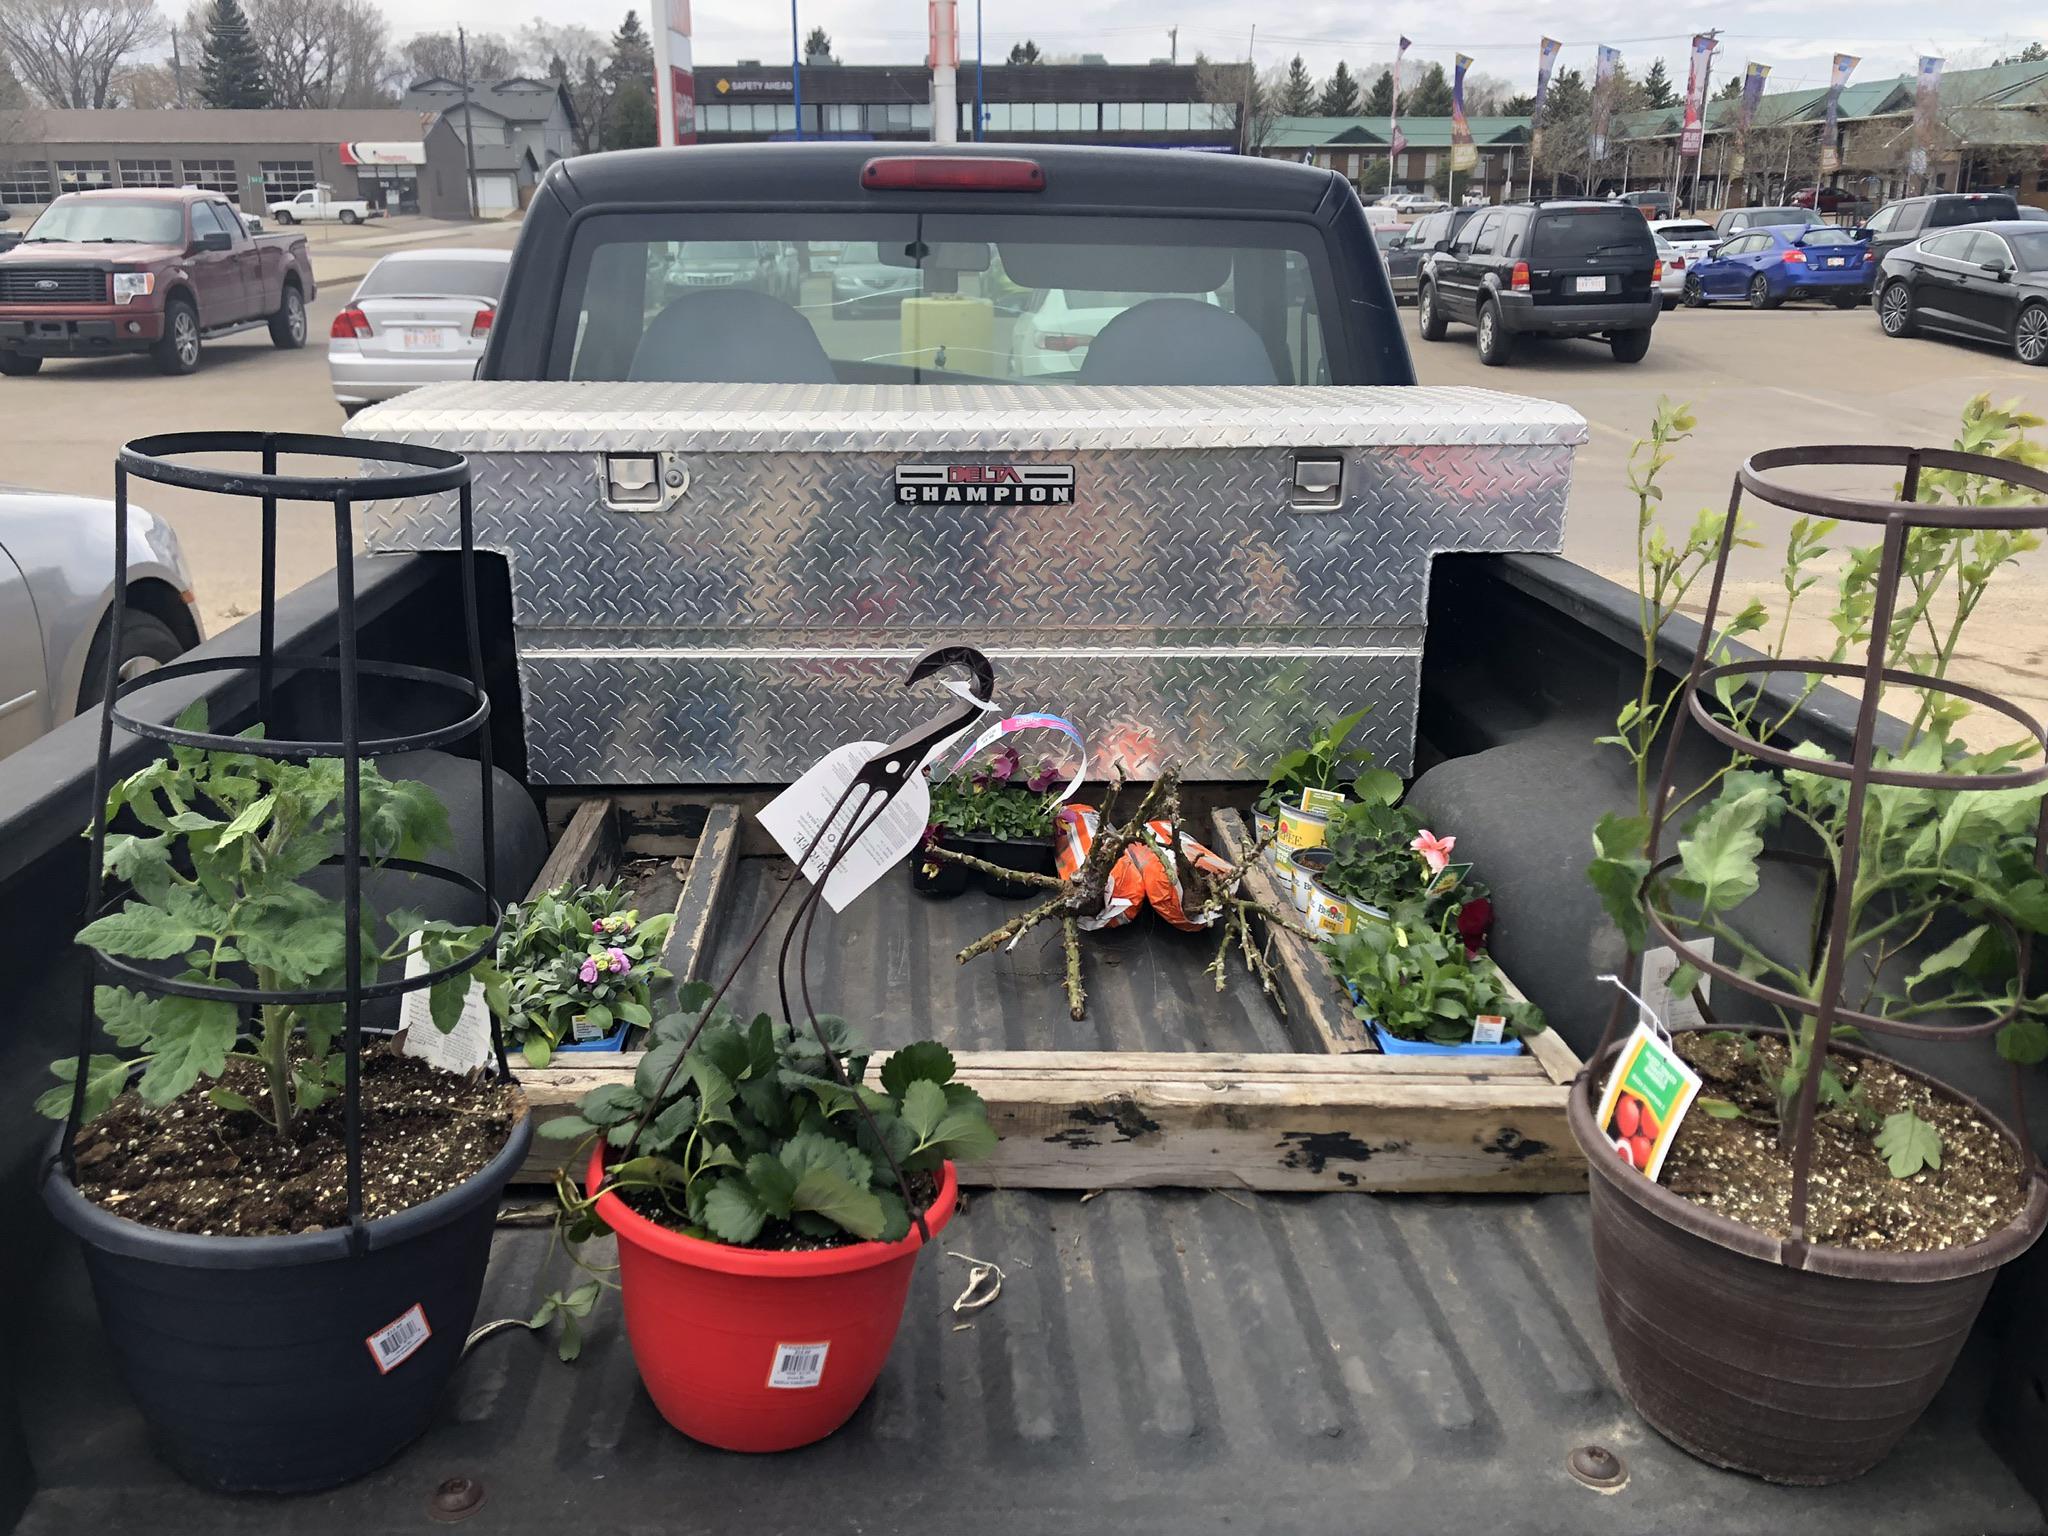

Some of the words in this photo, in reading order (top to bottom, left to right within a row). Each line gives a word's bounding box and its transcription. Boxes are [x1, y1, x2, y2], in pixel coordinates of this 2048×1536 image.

[732, 81, 762, 90] SAFETY
[764, 81, 793, 90] AHEAD
[948, 466, 1023, 484] DELTA
[900, 486, 1070, 502] CHAMPION
[793, 831, 828, 873] BUREE
